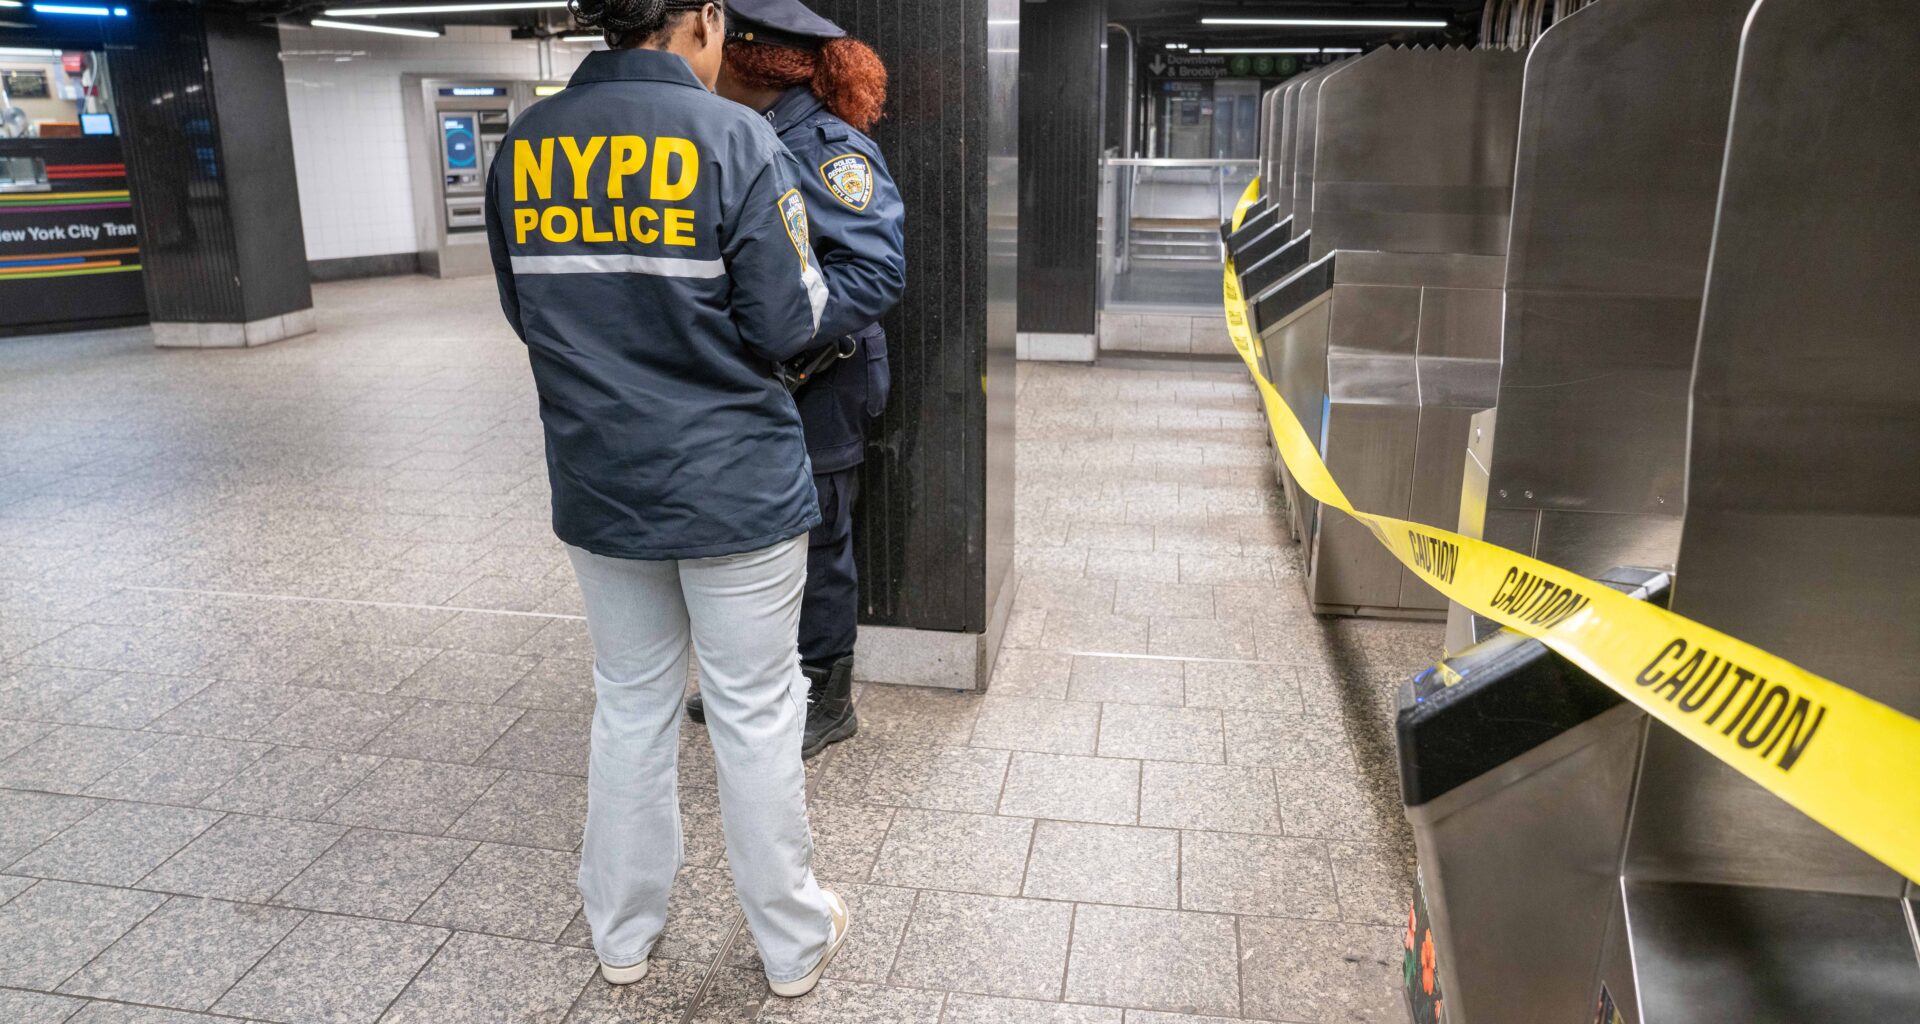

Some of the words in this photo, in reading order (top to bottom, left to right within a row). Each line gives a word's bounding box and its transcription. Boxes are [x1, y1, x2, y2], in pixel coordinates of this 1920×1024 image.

[1167, 54, 1225, 65] Downtown
[1167, 67, 1176, 77] &
[1180, 66, 1228, 79] Brooklyn
[514, 135, 699, 202] NYPD
[0, 229, 26, 242] ew
[27, 226, 66, 241] York
[67, 224, 100, 241] City
[514, 206, 696, 246] POLICE
[1408, 530, 1459, 585] CAUTION
[1490, 566, 1591, 630] CAUTION
[1635, 638, 1827, 772] CAUTION
